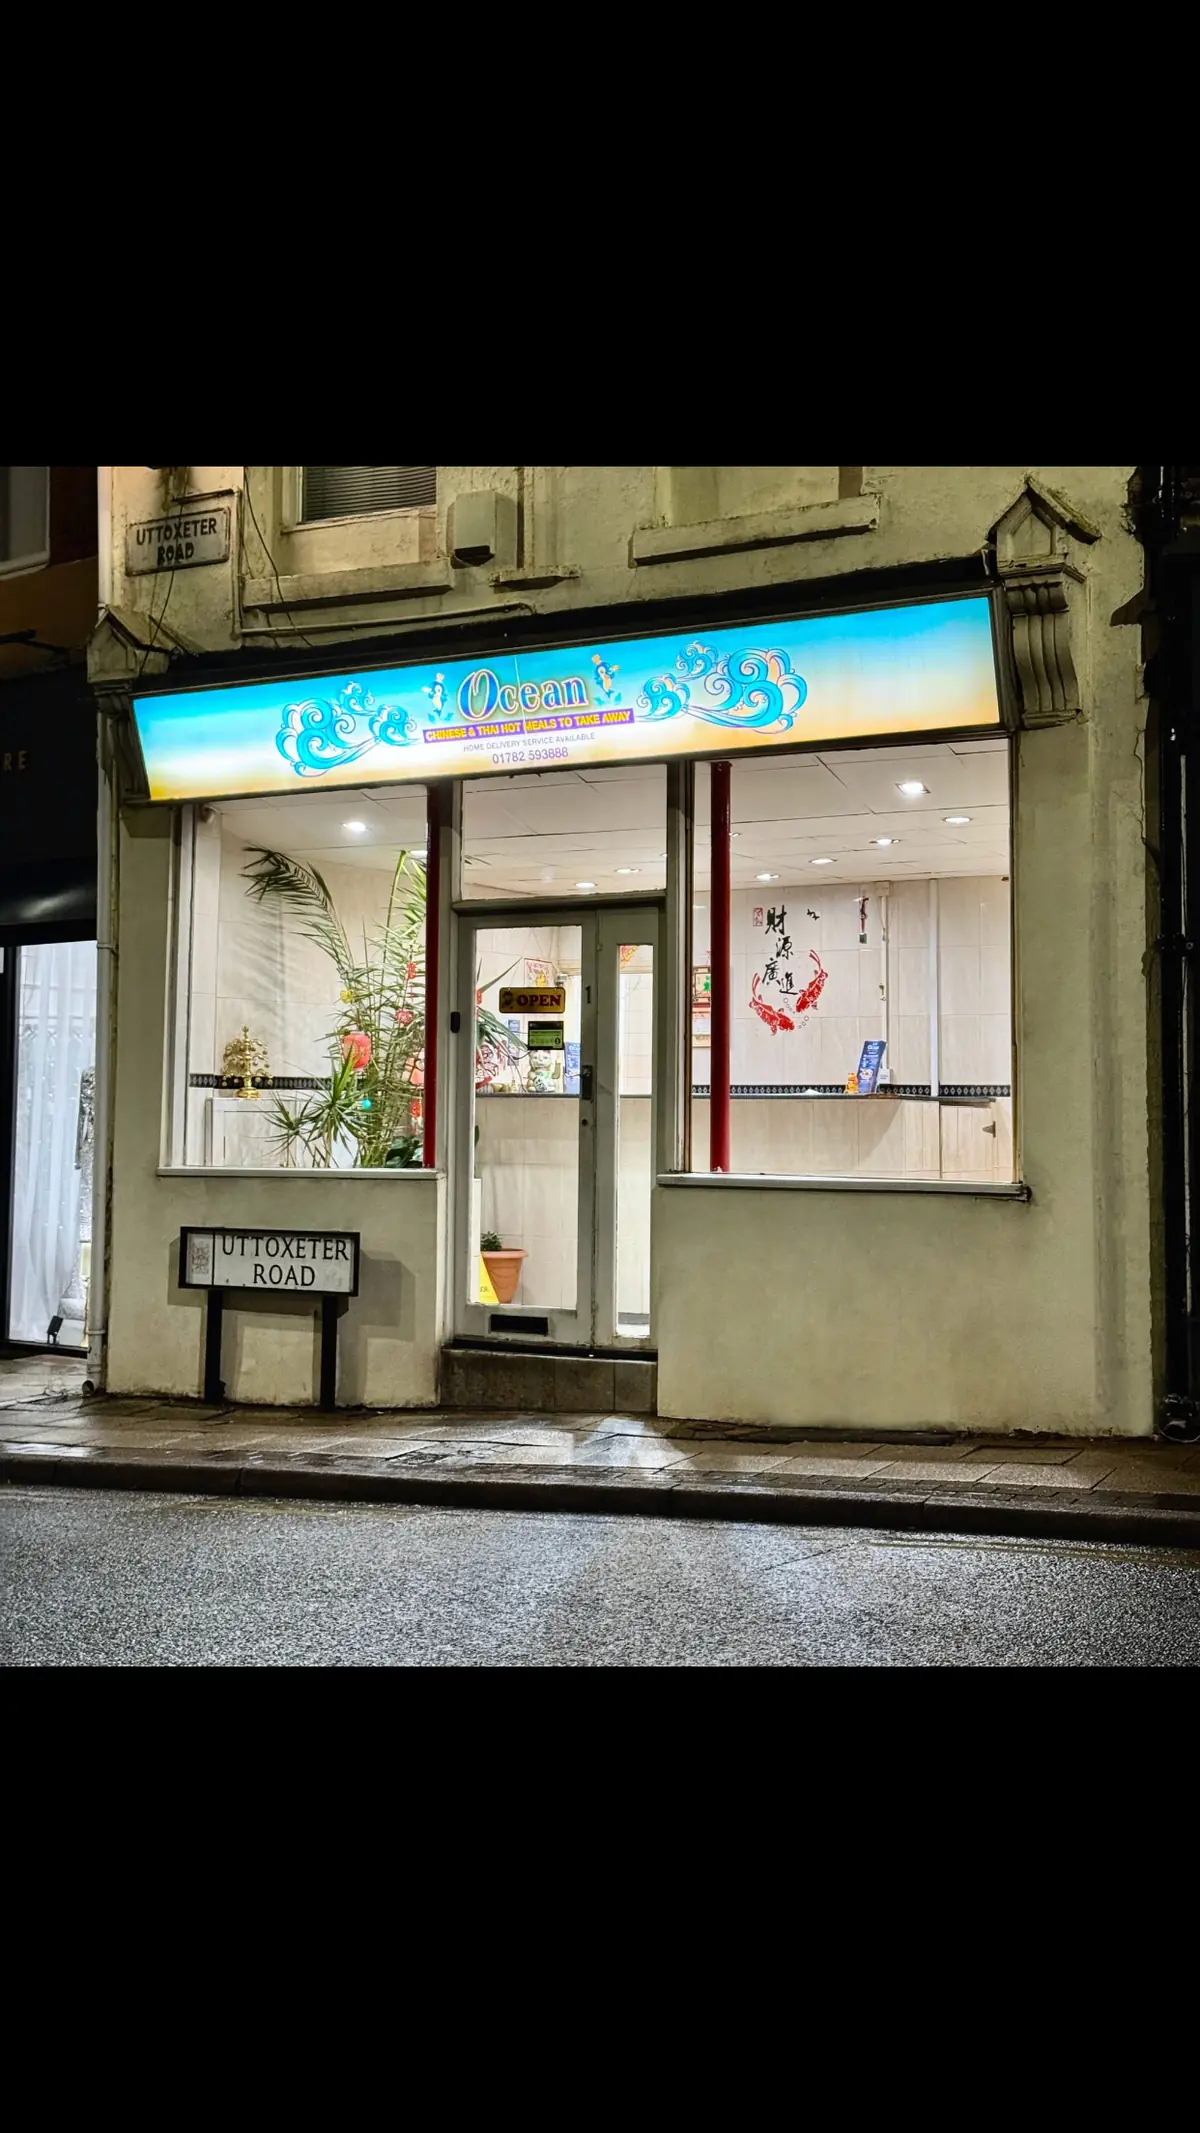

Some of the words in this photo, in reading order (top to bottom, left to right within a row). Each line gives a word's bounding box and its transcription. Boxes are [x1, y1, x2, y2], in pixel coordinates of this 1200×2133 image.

[136, 517, 218, 545] UTTOXETER
[157, 542, 195, 566] ROAD
[457, 668, 589, 721] Ocean
[426, 728, 467, 741] CHINESE
[468, 727, 475, 737] &
[477, 724, 499, 735] THAI
[501, 722, 521, 733] HOT
[525, 719, 556, 731] MEALS
[558, 718, 573, 728] TO
[574, 714, 600, 726] TAKE
[602, 711, 630, 723] AWAY
[464, 743, 485, 752] HOME
[486, 740, 520, 750] DELIVERY
[523, 736, 555, 746] SERVICE
[556, 732, 595, 743] AVAILABLE
[492, 751, 525, 764] 01782
[528, 746, 568, 761] 593888
[516, 994, 562, 1007] OPEN
[585, 985, 592, 1004] 1
[222, 1235, 350, 1261] UTTOXETER
[253, 1263, 316, 1287] ROAD
